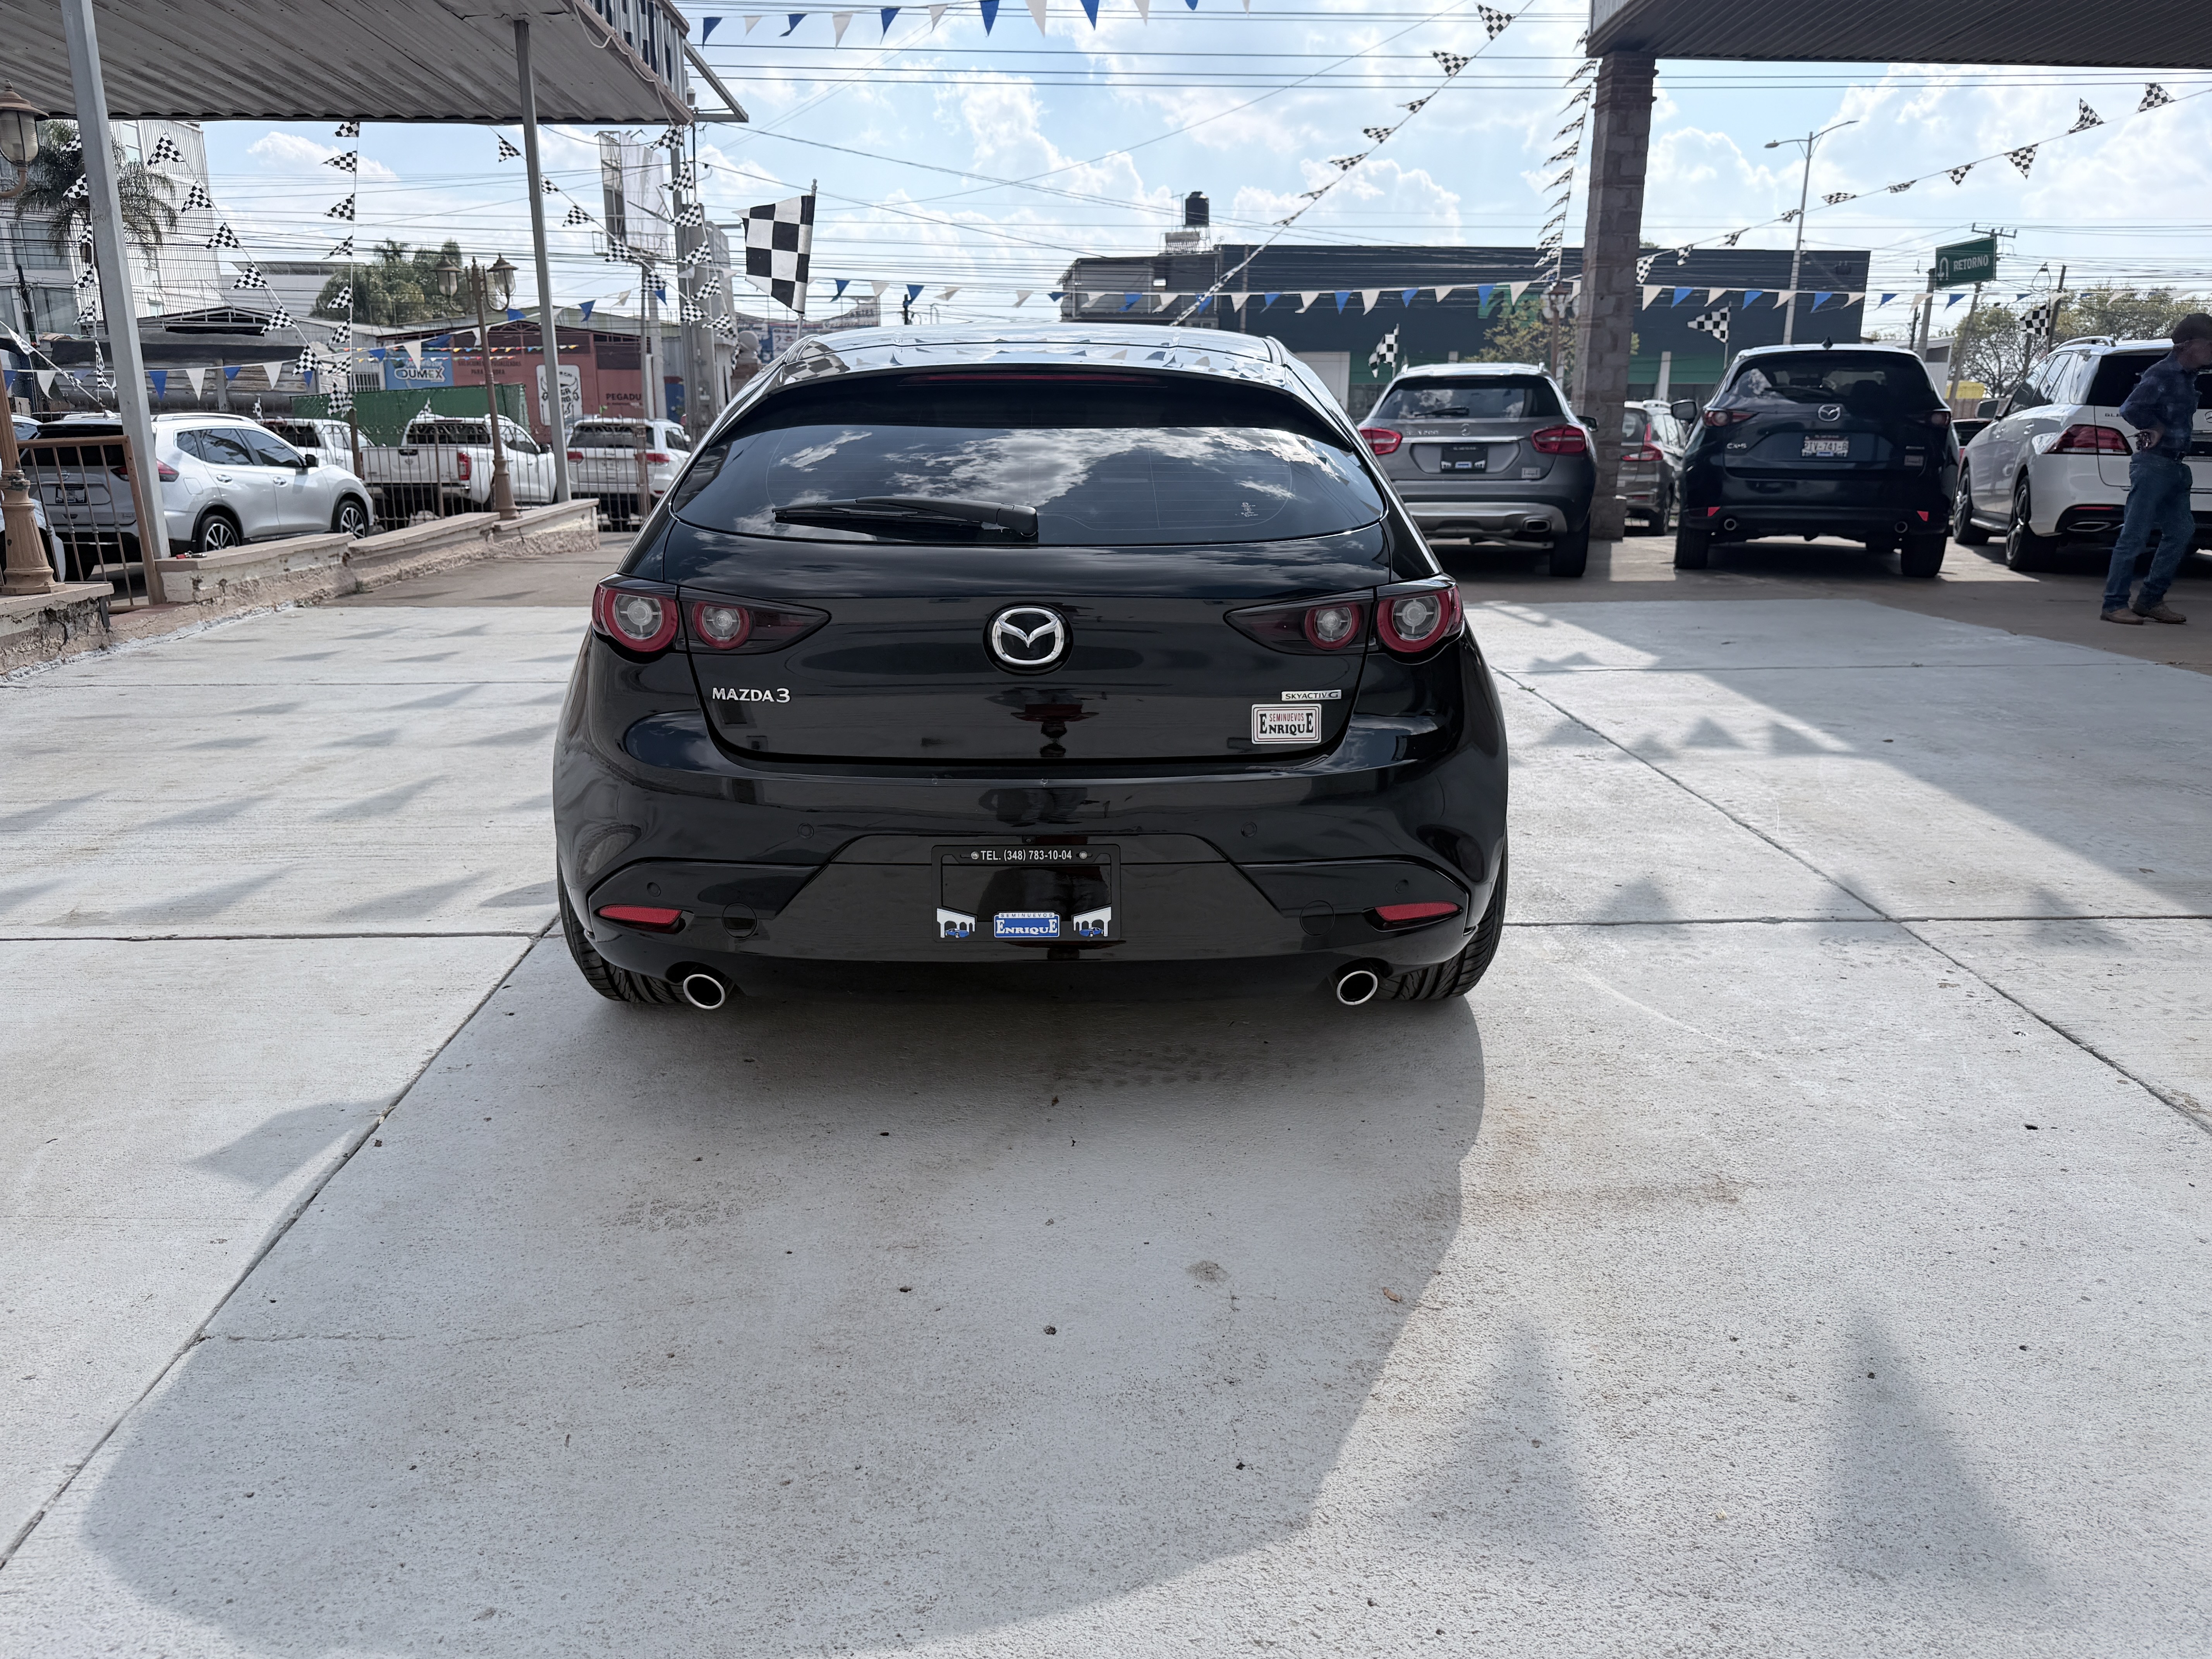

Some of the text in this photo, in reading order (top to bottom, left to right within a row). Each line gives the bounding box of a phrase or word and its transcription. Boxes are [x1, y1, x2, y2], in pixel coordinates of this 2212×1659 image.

[1953, 255, 1989, 271] RETORNO
[1259, 713, 1314, 736] ENRIQUE
[1269, 713, 1304, 722] SEMINUEVOS
[981, 849, 1072, 861] TEL. (348) 783-10-04
[996, 919, 1058, 935] ENRIQUE
